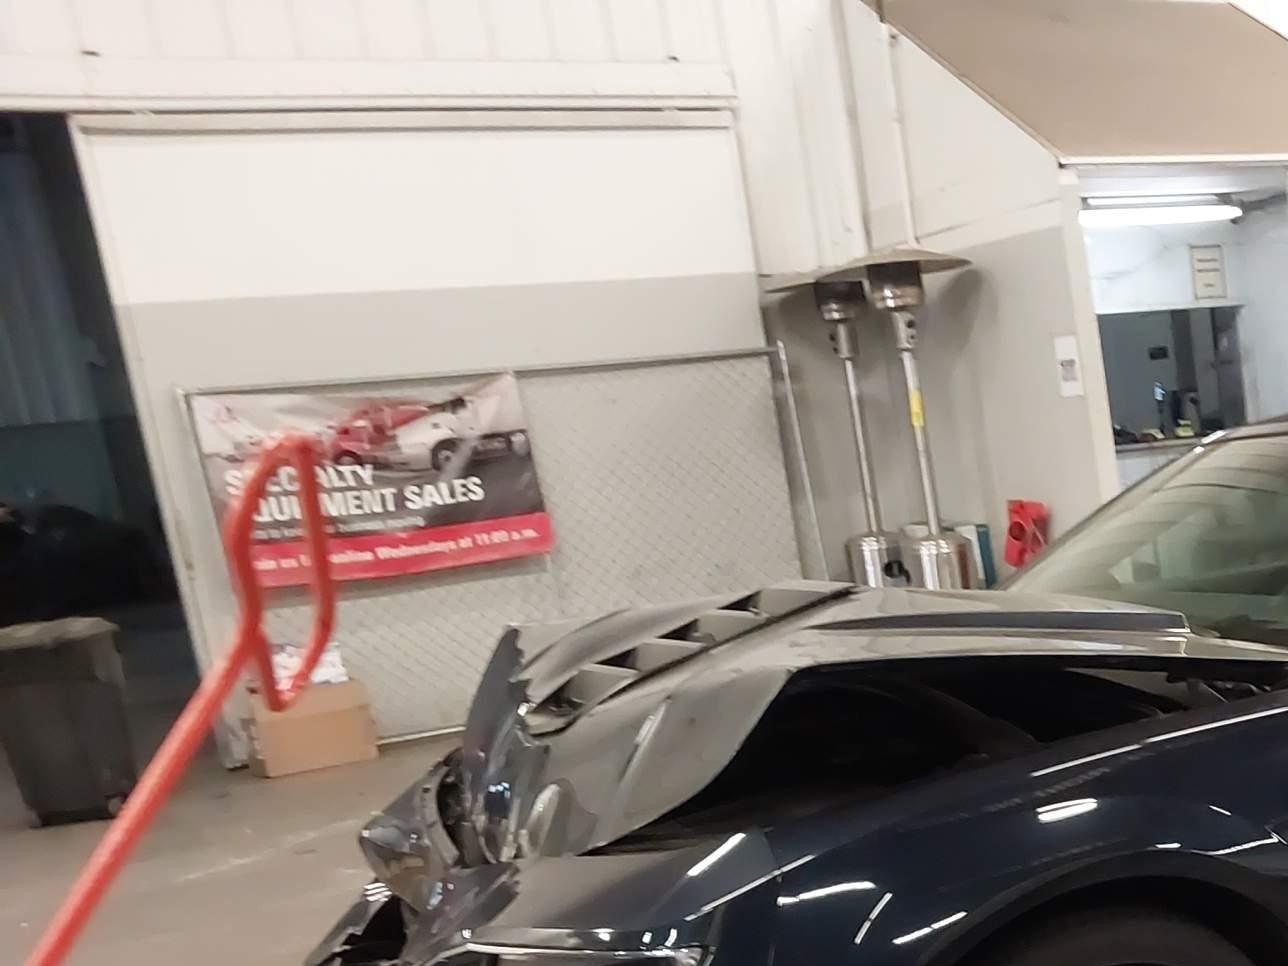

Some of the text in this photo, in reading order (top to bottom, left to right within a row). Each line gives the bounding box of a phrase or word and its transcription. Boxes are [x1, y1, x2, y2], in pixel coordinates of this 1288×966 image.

[224, 464, 374, 496] SECALTY
[252, 476, 485, 522] UIMENT SALES
